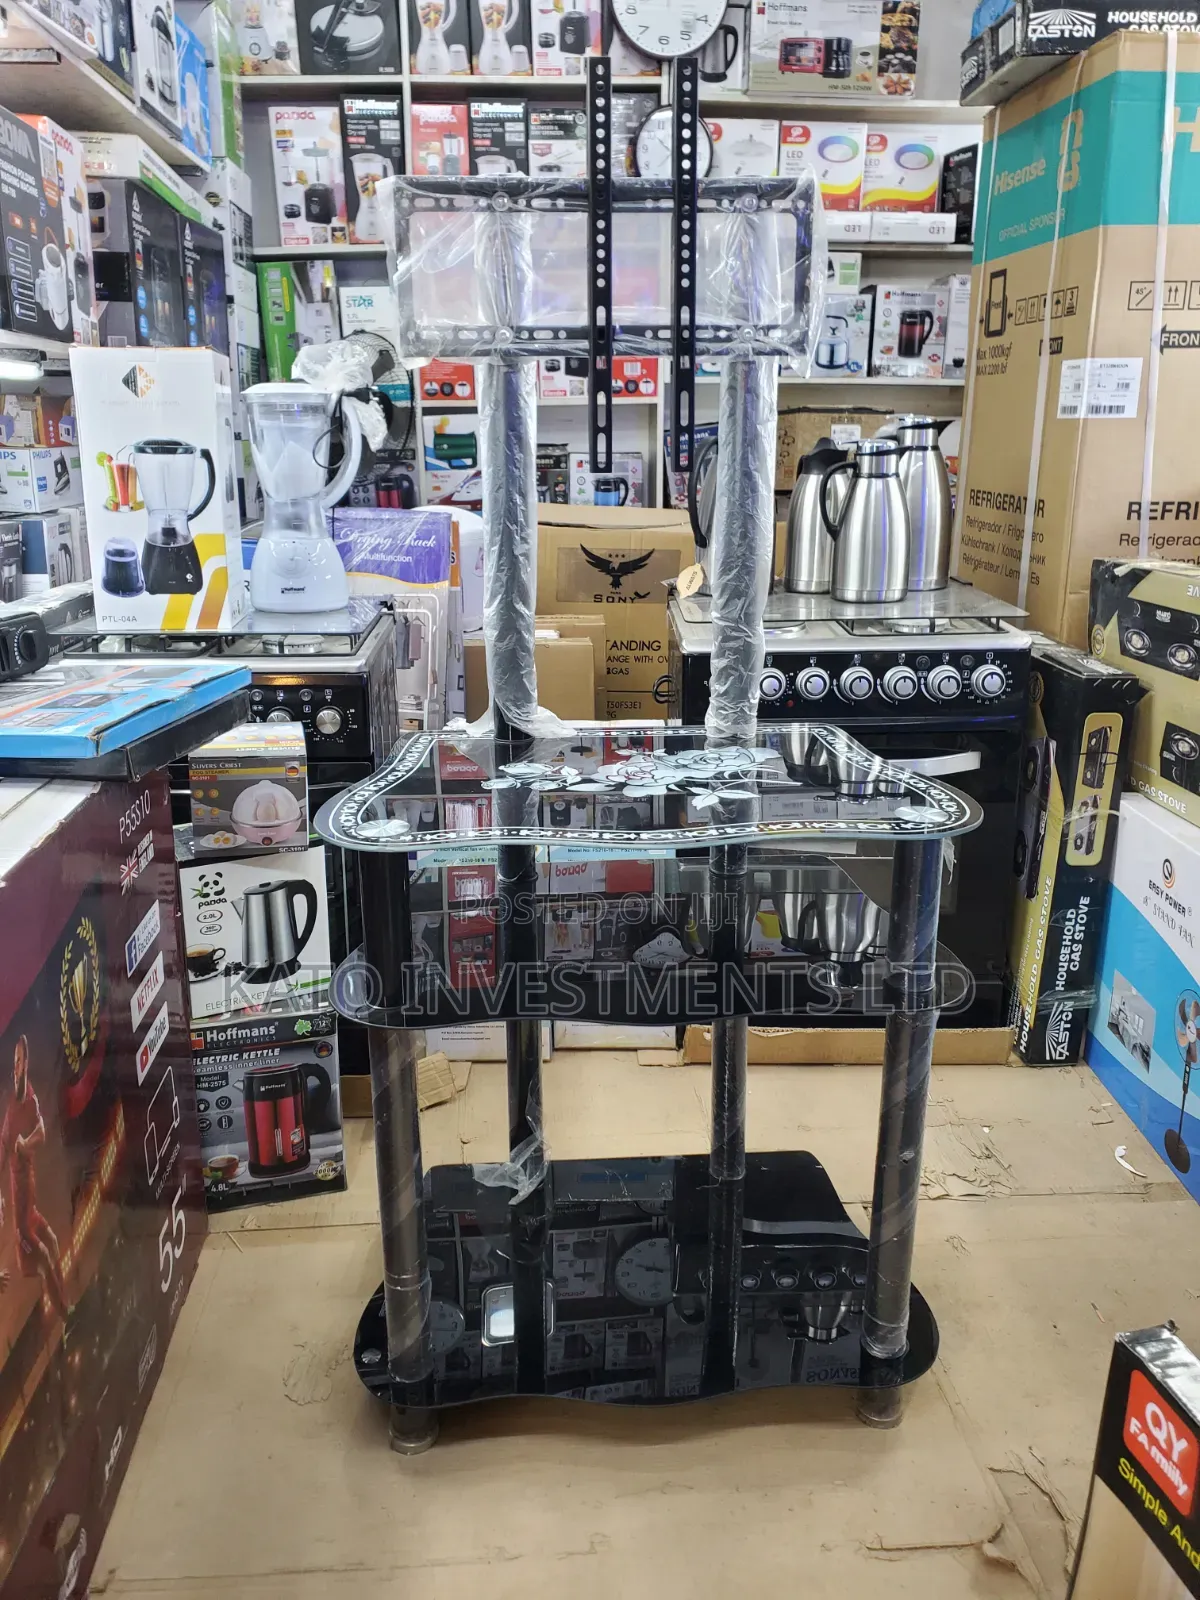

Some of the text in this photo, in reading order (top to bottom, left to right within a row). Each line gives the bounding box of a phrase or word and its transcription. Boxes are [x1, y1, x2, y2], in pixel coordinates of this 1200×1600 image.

[625, 5, 637, 15] 8
[1107, 11, 1198, 24] HOUSEHOLD
[638, 25, 650, 35] 7
[680, 31, 692, 41] 5
[658, 36, 670, 46] 6
[786, 150, 803, 159] LED
[994, 159, 1047, 195] Hisense
[998, 220, 1028, 241] OFFICIAL
[32, 450, 52, 459] PHILIPS
[969, 488, 1045, 518] REFRIGERATR
[966, 515, 1002, 533] Refrigerador
[593, 594, 637, 604] SONY
[102, 615, 137, 623] PTL-04A
[634, 655, 653, 664] WITH
[1138, 780, 1156, 797] GAS
[1158, 790, 1187, 814] STOVE
[198, 898, 227, 910] panda
[1164, 892, 1187, 918] POWER
[1069, 895, 1090, 972] GAS STOVE
[1055, 907, 1077, 992] HOUSEHOLD
[1019, 875, 1053, 1053] HOUSEHOLD GAS STOVE
[136, 966, 160, 1016] NETFLIX
[205, 995, 249, 1011] ELECTRIC
[149, 1015, 168, 1054] YouTube
[206, 1024, 276, 1043] Hoffmans
[207, 1036, 276, 1049] ELECTRONICS
[243, 1048, 281, 1061] KETTLE
[194, 1057, 280, 1074] eamless inner liner
[211, 1183, 229, 1193] 4.8L
[1145, 1402, 1189, 1463] QY
[1118, 1457, 1169, 1526] Simple
